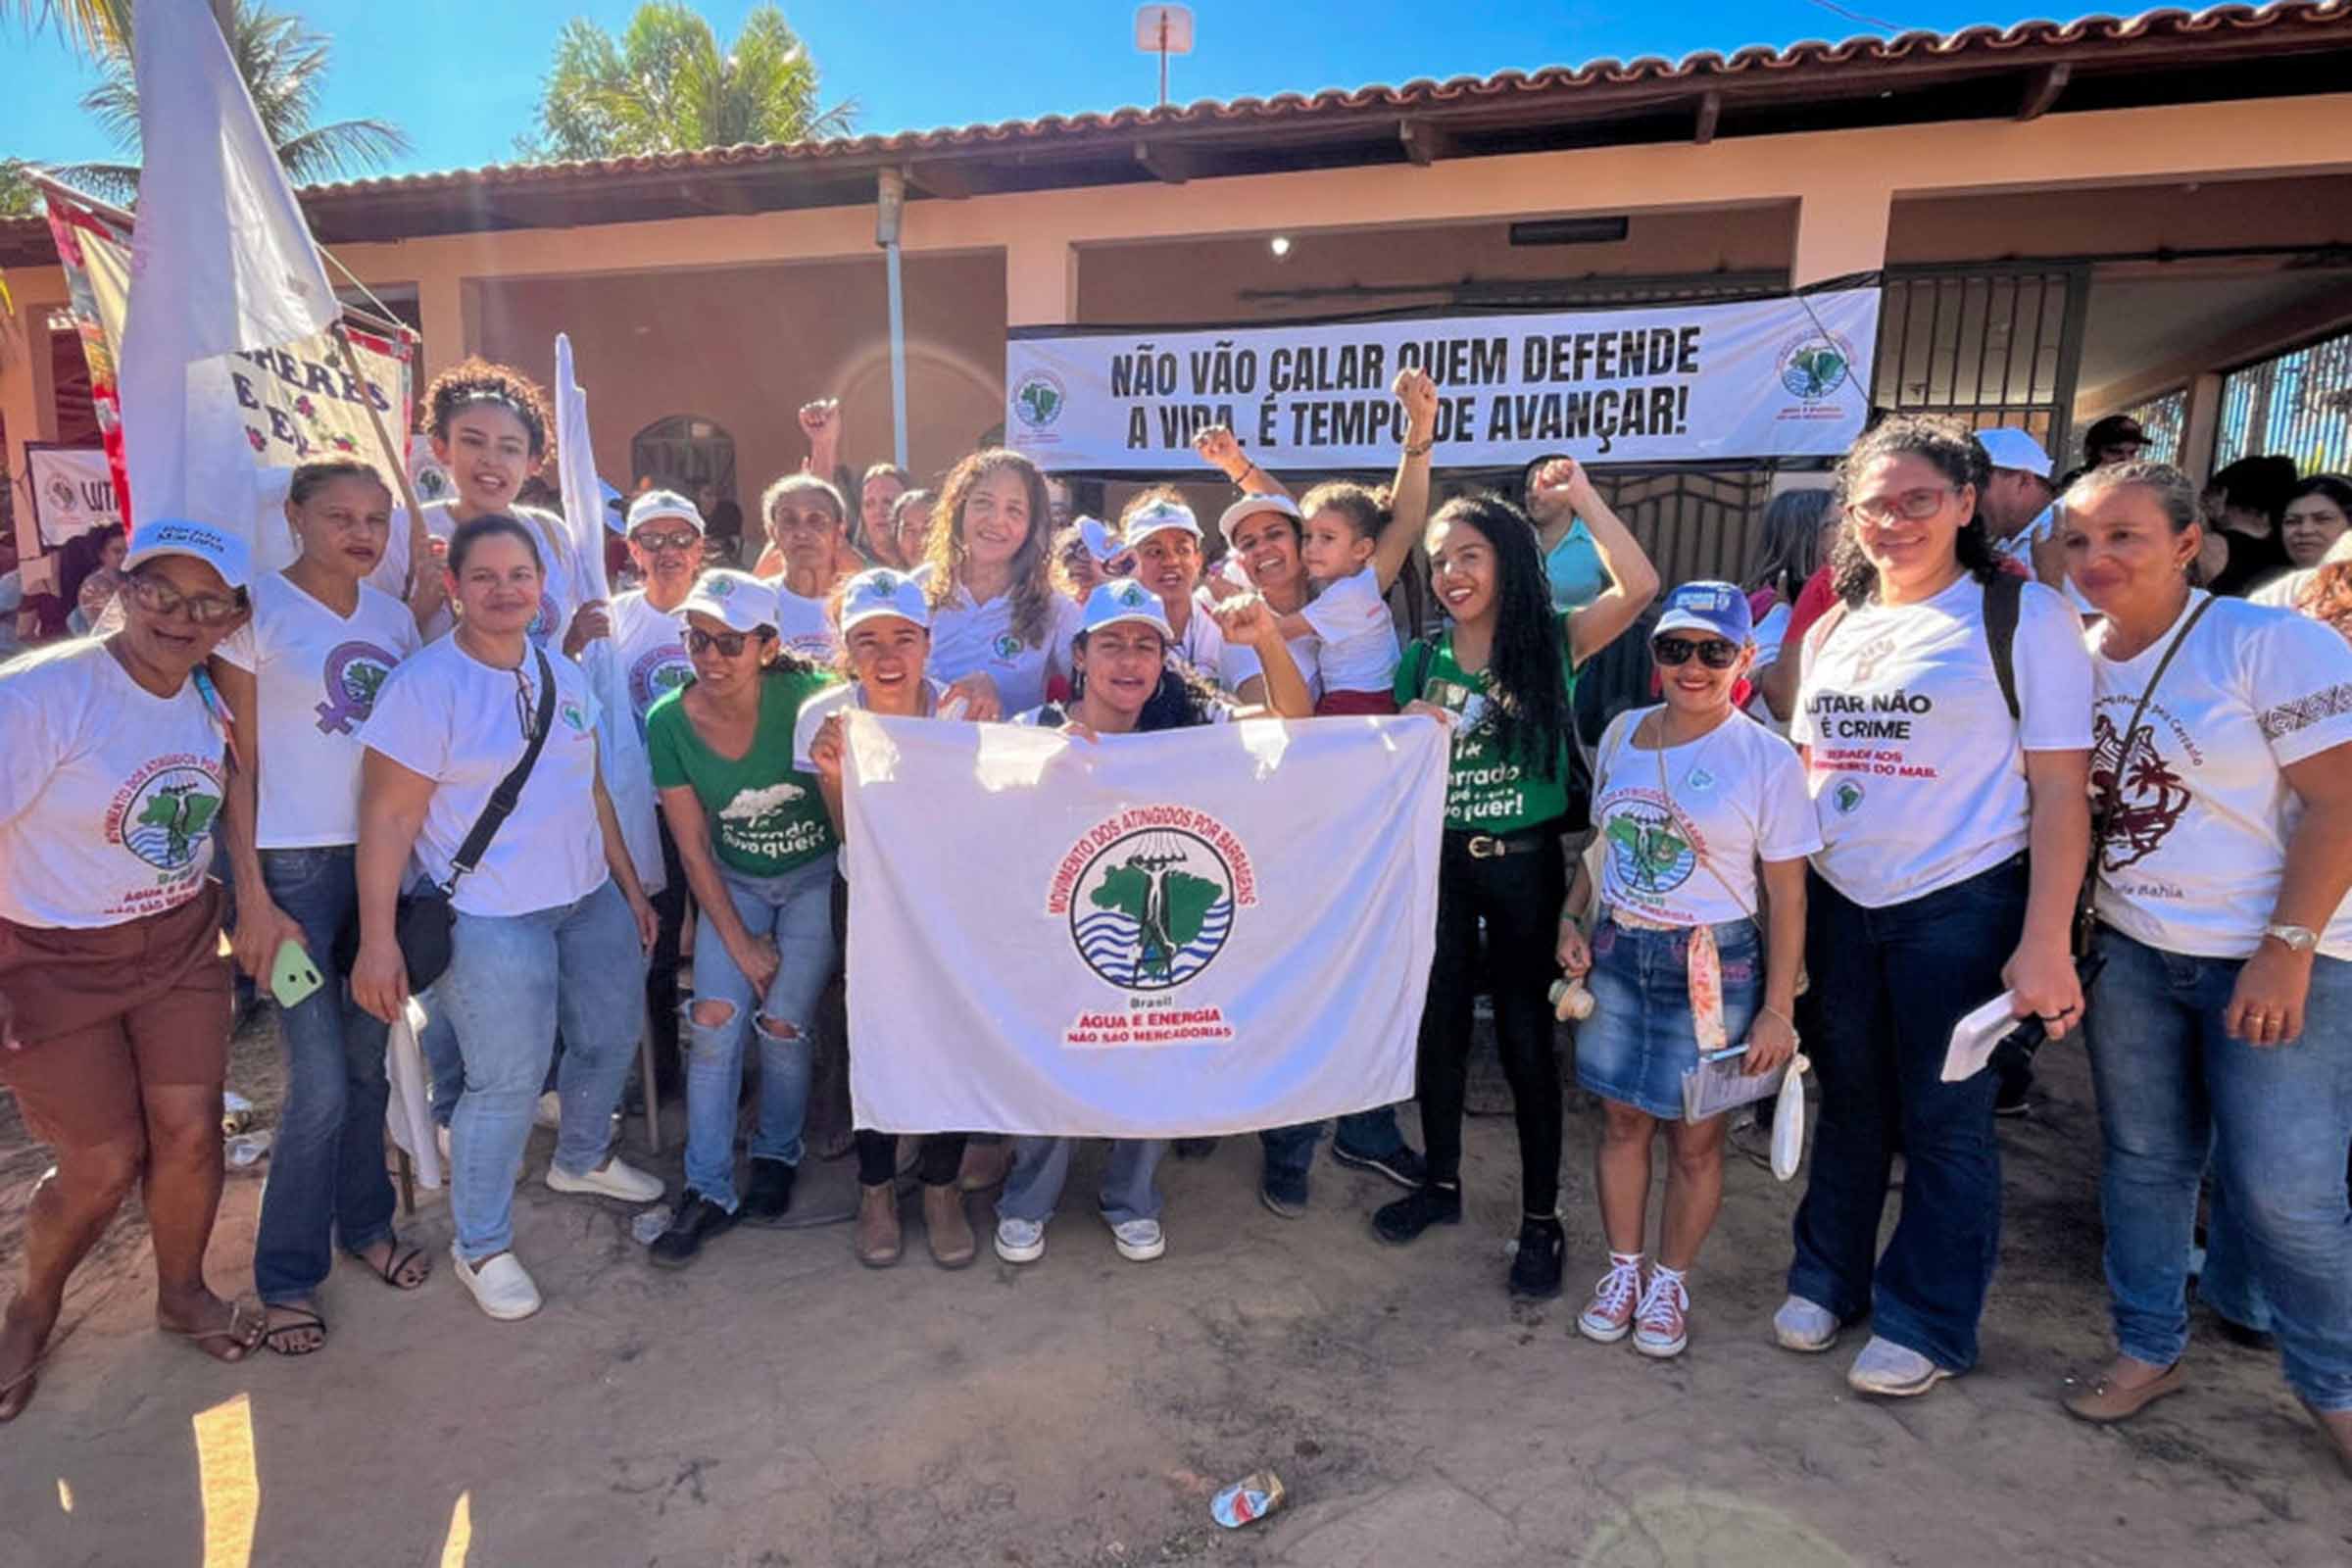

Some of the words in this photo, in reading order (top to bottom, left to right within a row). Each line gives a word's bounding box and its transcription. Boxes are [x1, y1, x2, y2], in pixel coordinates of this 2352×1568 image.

[1111, 344, 1177, 398] NÃO
[1190, 340, 1256, 395] VÃO
[1270, 344, 1384, 393] CALAR
[1399, 336, 1509, 389] QUEM
[1522, 326, 1701, 384] DEFENDE
[1127, 405, 1148, 449] A
[1259, 392, 1277, 447] É
[1434, 395, 1476, 443] DE
[1488, 386, 1690, 454] AVANÇAR!
[1871, 688, 1933, 714] NÃO
[1821, 715, 1833, 739] É
[1838, 719, 1912, 741] CRIME
[1050, 839, 1095, 913] MOVIMENTO
[1091, 819, 1121, 846] DOS
[1122, 807, 1193, 829] ATINGIDOS
[1195, 813, 1221, 840] POR
[1215, 830, 1256, 905] BARRAGENS
[1130, 996, 1172, 1009] Brasil
[1132, 1013, 1143, 1027] E
[1148, 1008, 1221, 1027] ENERGIA
[1134, 1026, 1232, 1042] MERCADORIAS
